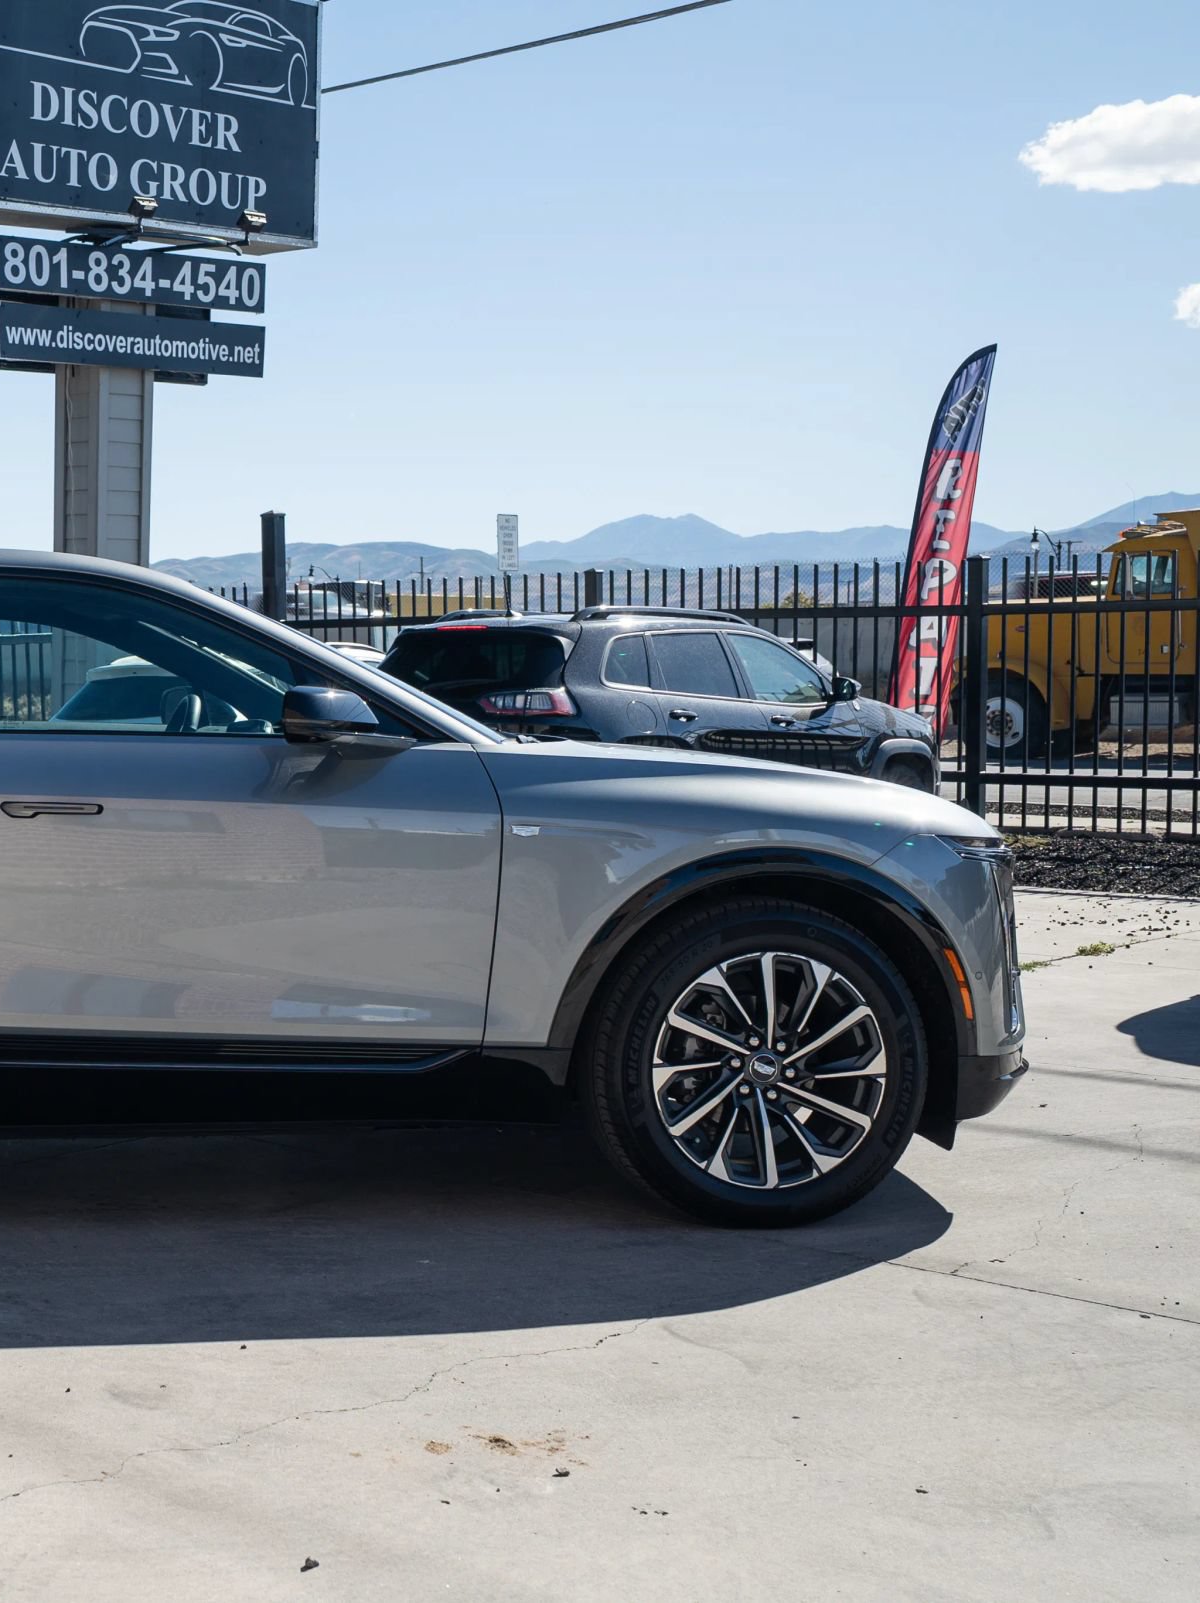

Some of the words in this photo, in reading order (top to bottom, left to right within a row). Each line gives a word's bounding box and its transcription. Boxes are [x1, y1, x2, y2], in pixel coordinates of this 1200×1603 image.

[29, 80, 242, 153] DISCOVER
[129, 158, 267, 211] GROUP
[3, 241, 261, 307] 801-834-4540
[5, 324, 260, 365] www.discoverautomotive.net
[627, 994, 657, 1085] MICHELIN
[886, 1056, 913, 1144] MICHELIN
